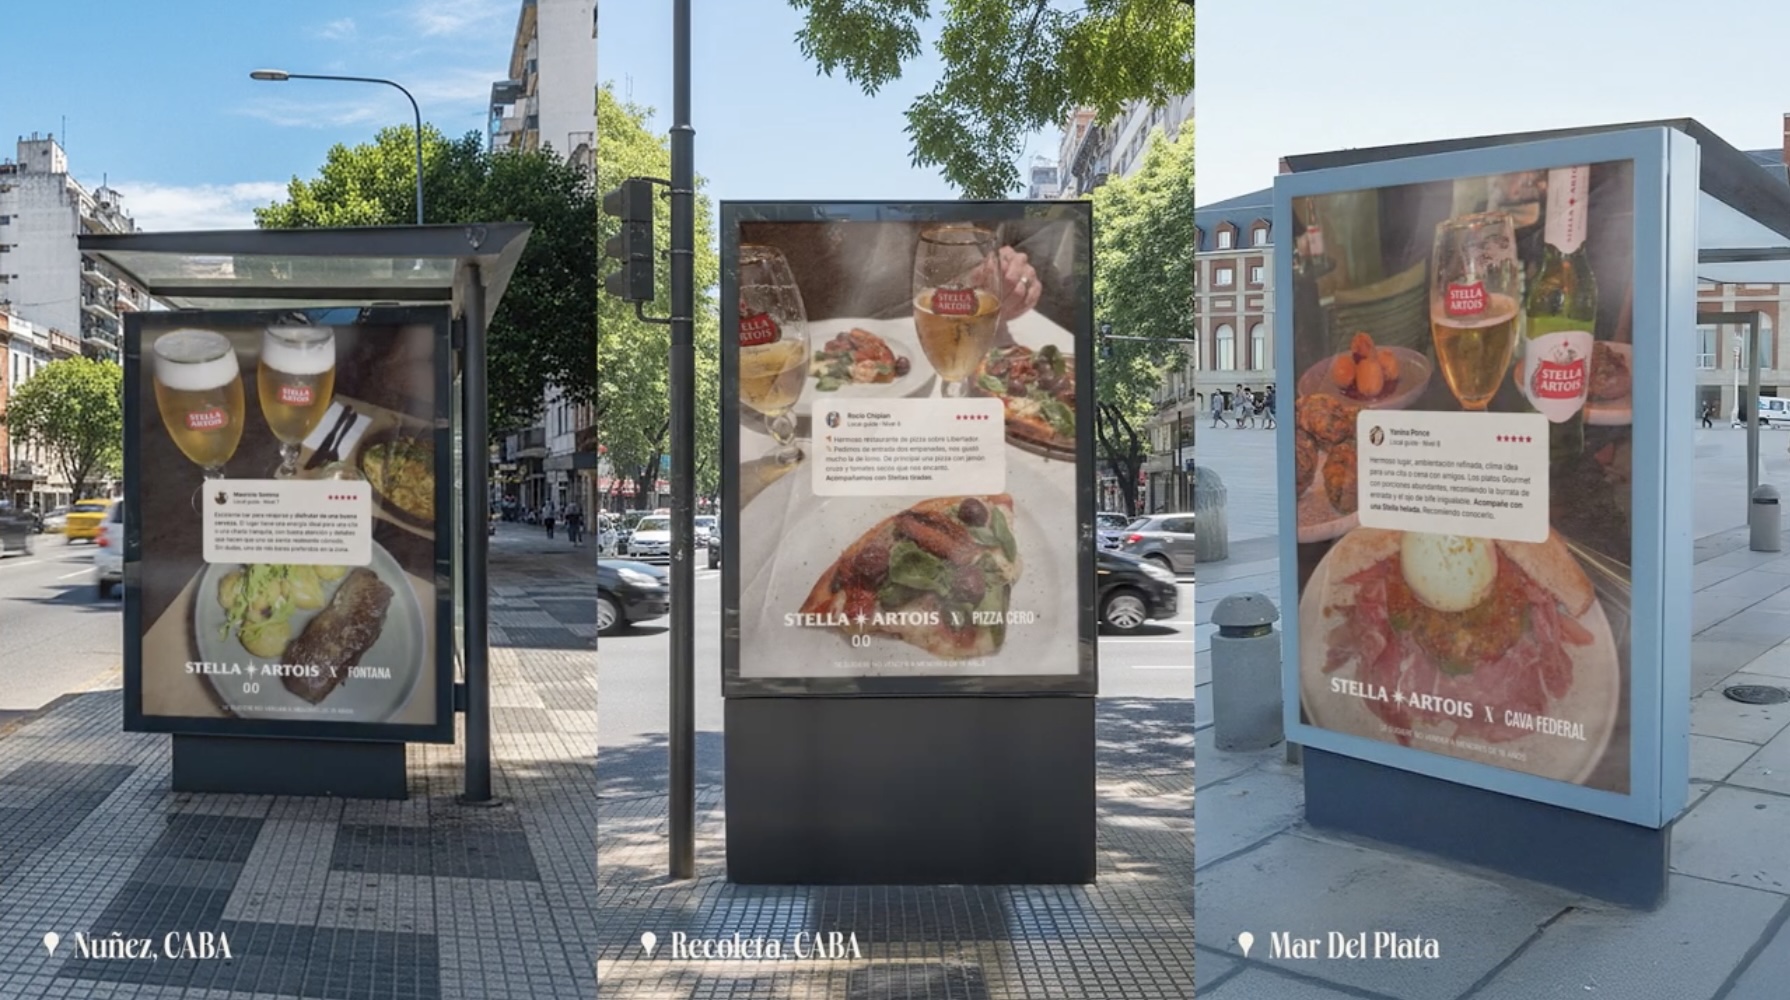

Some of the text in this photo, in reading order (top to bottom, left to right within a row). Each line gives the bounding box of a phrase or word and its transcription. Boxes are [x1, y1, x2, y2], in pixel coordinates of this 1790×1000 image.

[938, 292, 971, 301] STELLA
[1450, 288, 1482, 299] STELLA
[938, 301, 971, 311] ARTOIS
[1450, 300, 1483, 311] ARTOIS
[1542, 368, 1582, 380] STELLA
[1540, 380, 1581, 392] ARTOIS
[282, 388, 309, 396] STELLA
[189, 412, 221, 421] STELLA
[190, 419, 222, 428] ARTOIS
[1390, 428, 1430, 437] Yanina Ponce
[910, 436, 926, 444] pizza
[1369, 456, 1396, 464] Hermoso
[1456, 460, 1484, 470] refinada,
[1485, 462, 1503, 470] clima
[1468, 474, 1479, 482] Los
[1481, 475, 1501, 483] platos
[1502, 475, 1531, 485] Gourmet
[1450, 485, 1487, 494] recomiendo
[1496, 487, 1520, 496] burrata
[1382, 503, 1399, 512] Stella
[1423, 506, 1460, 517] Recomiendo
[784, 611, 1034, 627] STELLA ARTOIS X PIZZA CERO
[185, 662, 392, 679] STELLA ARTOIS X FONTANA
[1331, 677, 1587, 741] STELLA ARTOIS X CAVA FEDERAL
